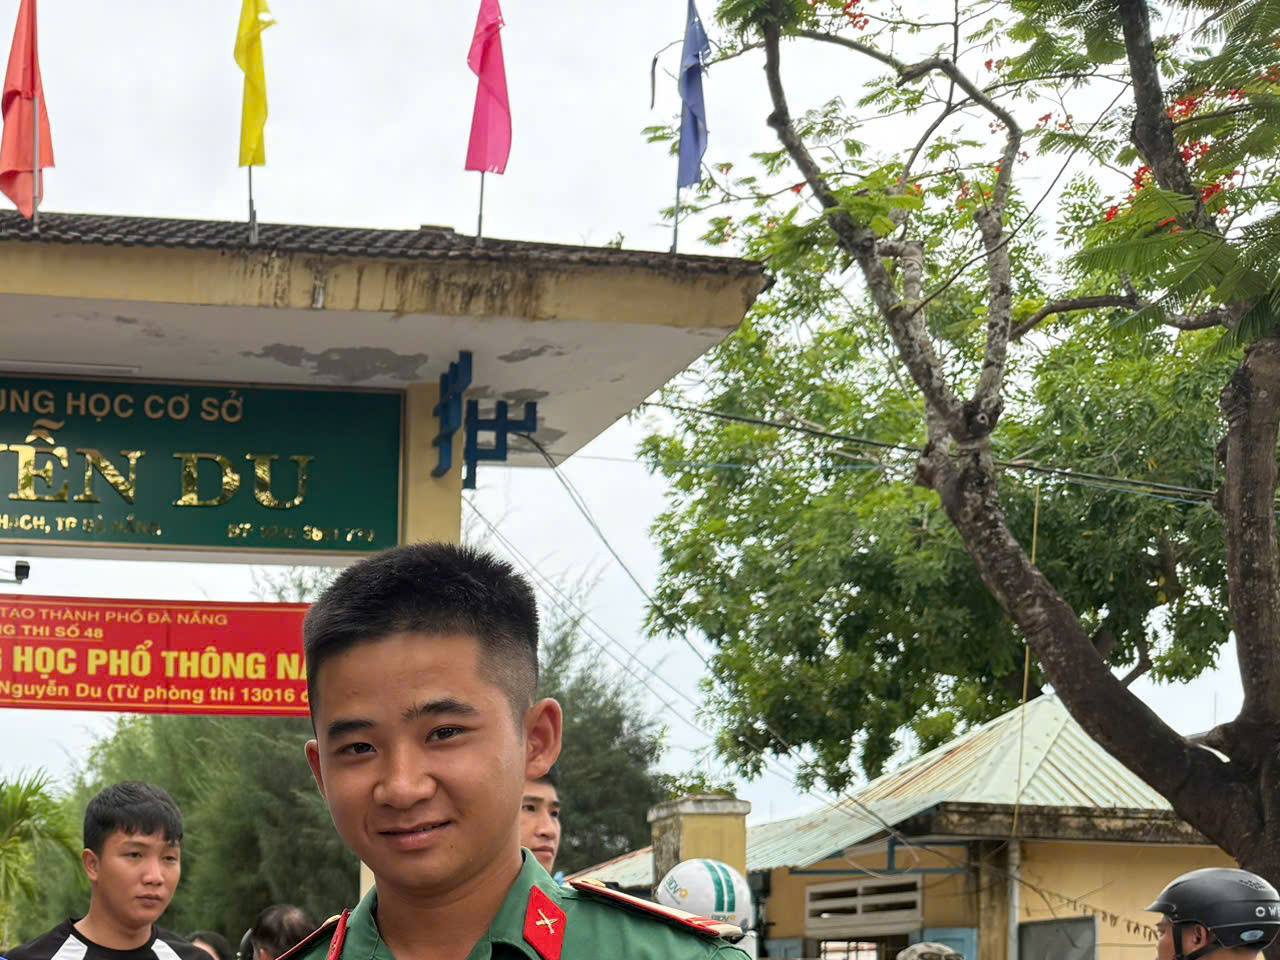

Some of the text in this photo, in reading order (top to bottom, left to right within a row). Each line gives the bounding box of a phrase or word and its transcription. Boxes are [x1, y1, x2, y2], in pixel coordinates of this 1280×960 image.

[67, 392, 134, 423] HỌC
[144, 394, 189, 421] CƠ
[201, 390, 243, 423] SỞ
[172, 452, 314, 509] DU
[0, 607, 35, 621] TẠO
[40, 607, 100, 622] THÀNH
[105, 608, 143, 623] PHỐ
[147, 609, 171, 624] ĐÀ
[176, 609, 228, 625] NẴNG
[21, 624, 50, 636] THI
[54, 623, 80, 638] SỐ
[84, 627, 104, 639] 48
[13, 643, 76, 680] HỌC
[87, 639, 153, 677] PHỔ
[161, 645, 266, 680] THÔNG
[76, 683, 101, 698] Du
[107, 684, 140, 701] (Từ
[143, 686, 204, 704] phòng
[210, 686, 235, 701] thi
[240, 688, 295, 702] 13016
